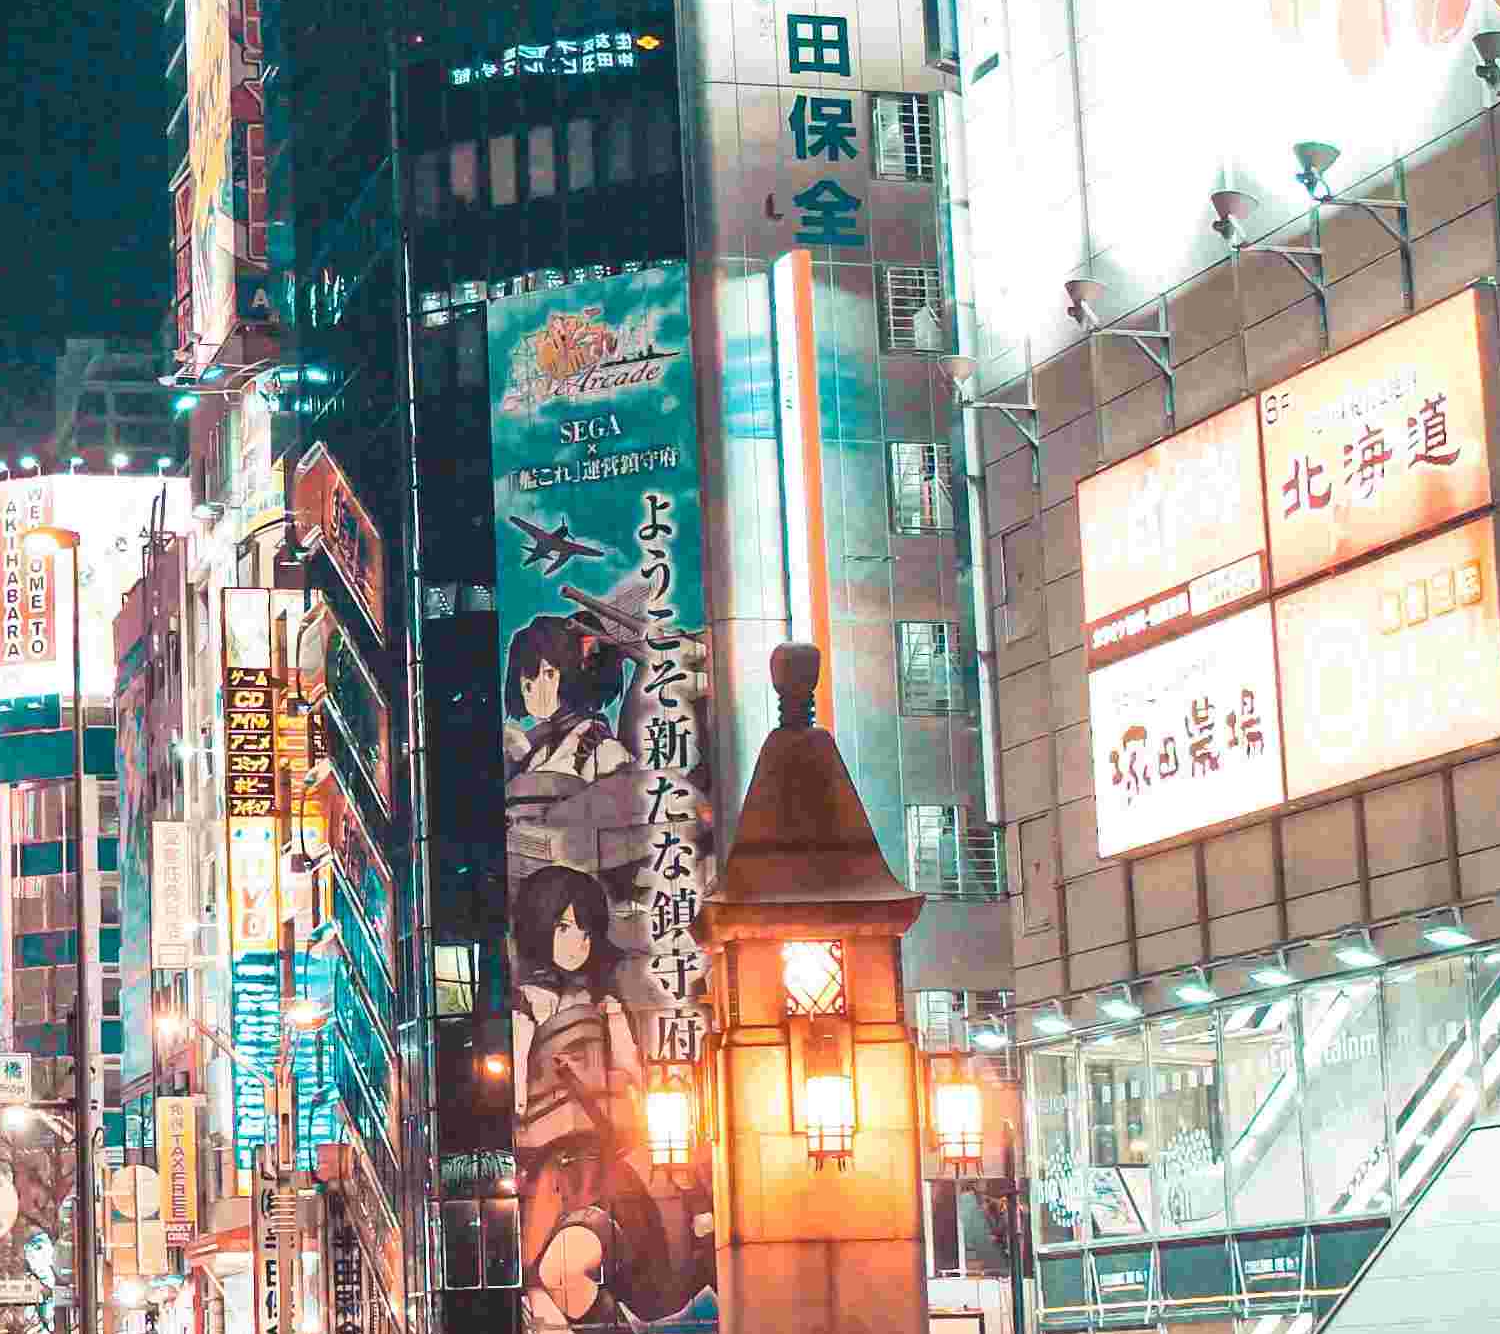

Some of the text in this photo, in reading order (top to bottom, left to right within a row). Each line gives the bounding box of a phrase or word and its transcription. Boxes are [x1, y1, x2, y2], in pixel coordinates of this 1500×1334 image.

[560, 413, 622, 444] SEGA
[1281, 391, 1462, 520] 北海道
[5, 500, 20, 658] AKIHABARA
[28, 486, 45, 609] WEOME
[234, 690, 266, 708] CD
[637, 493, 704, 1063] ようこそ新たな鎮守府
